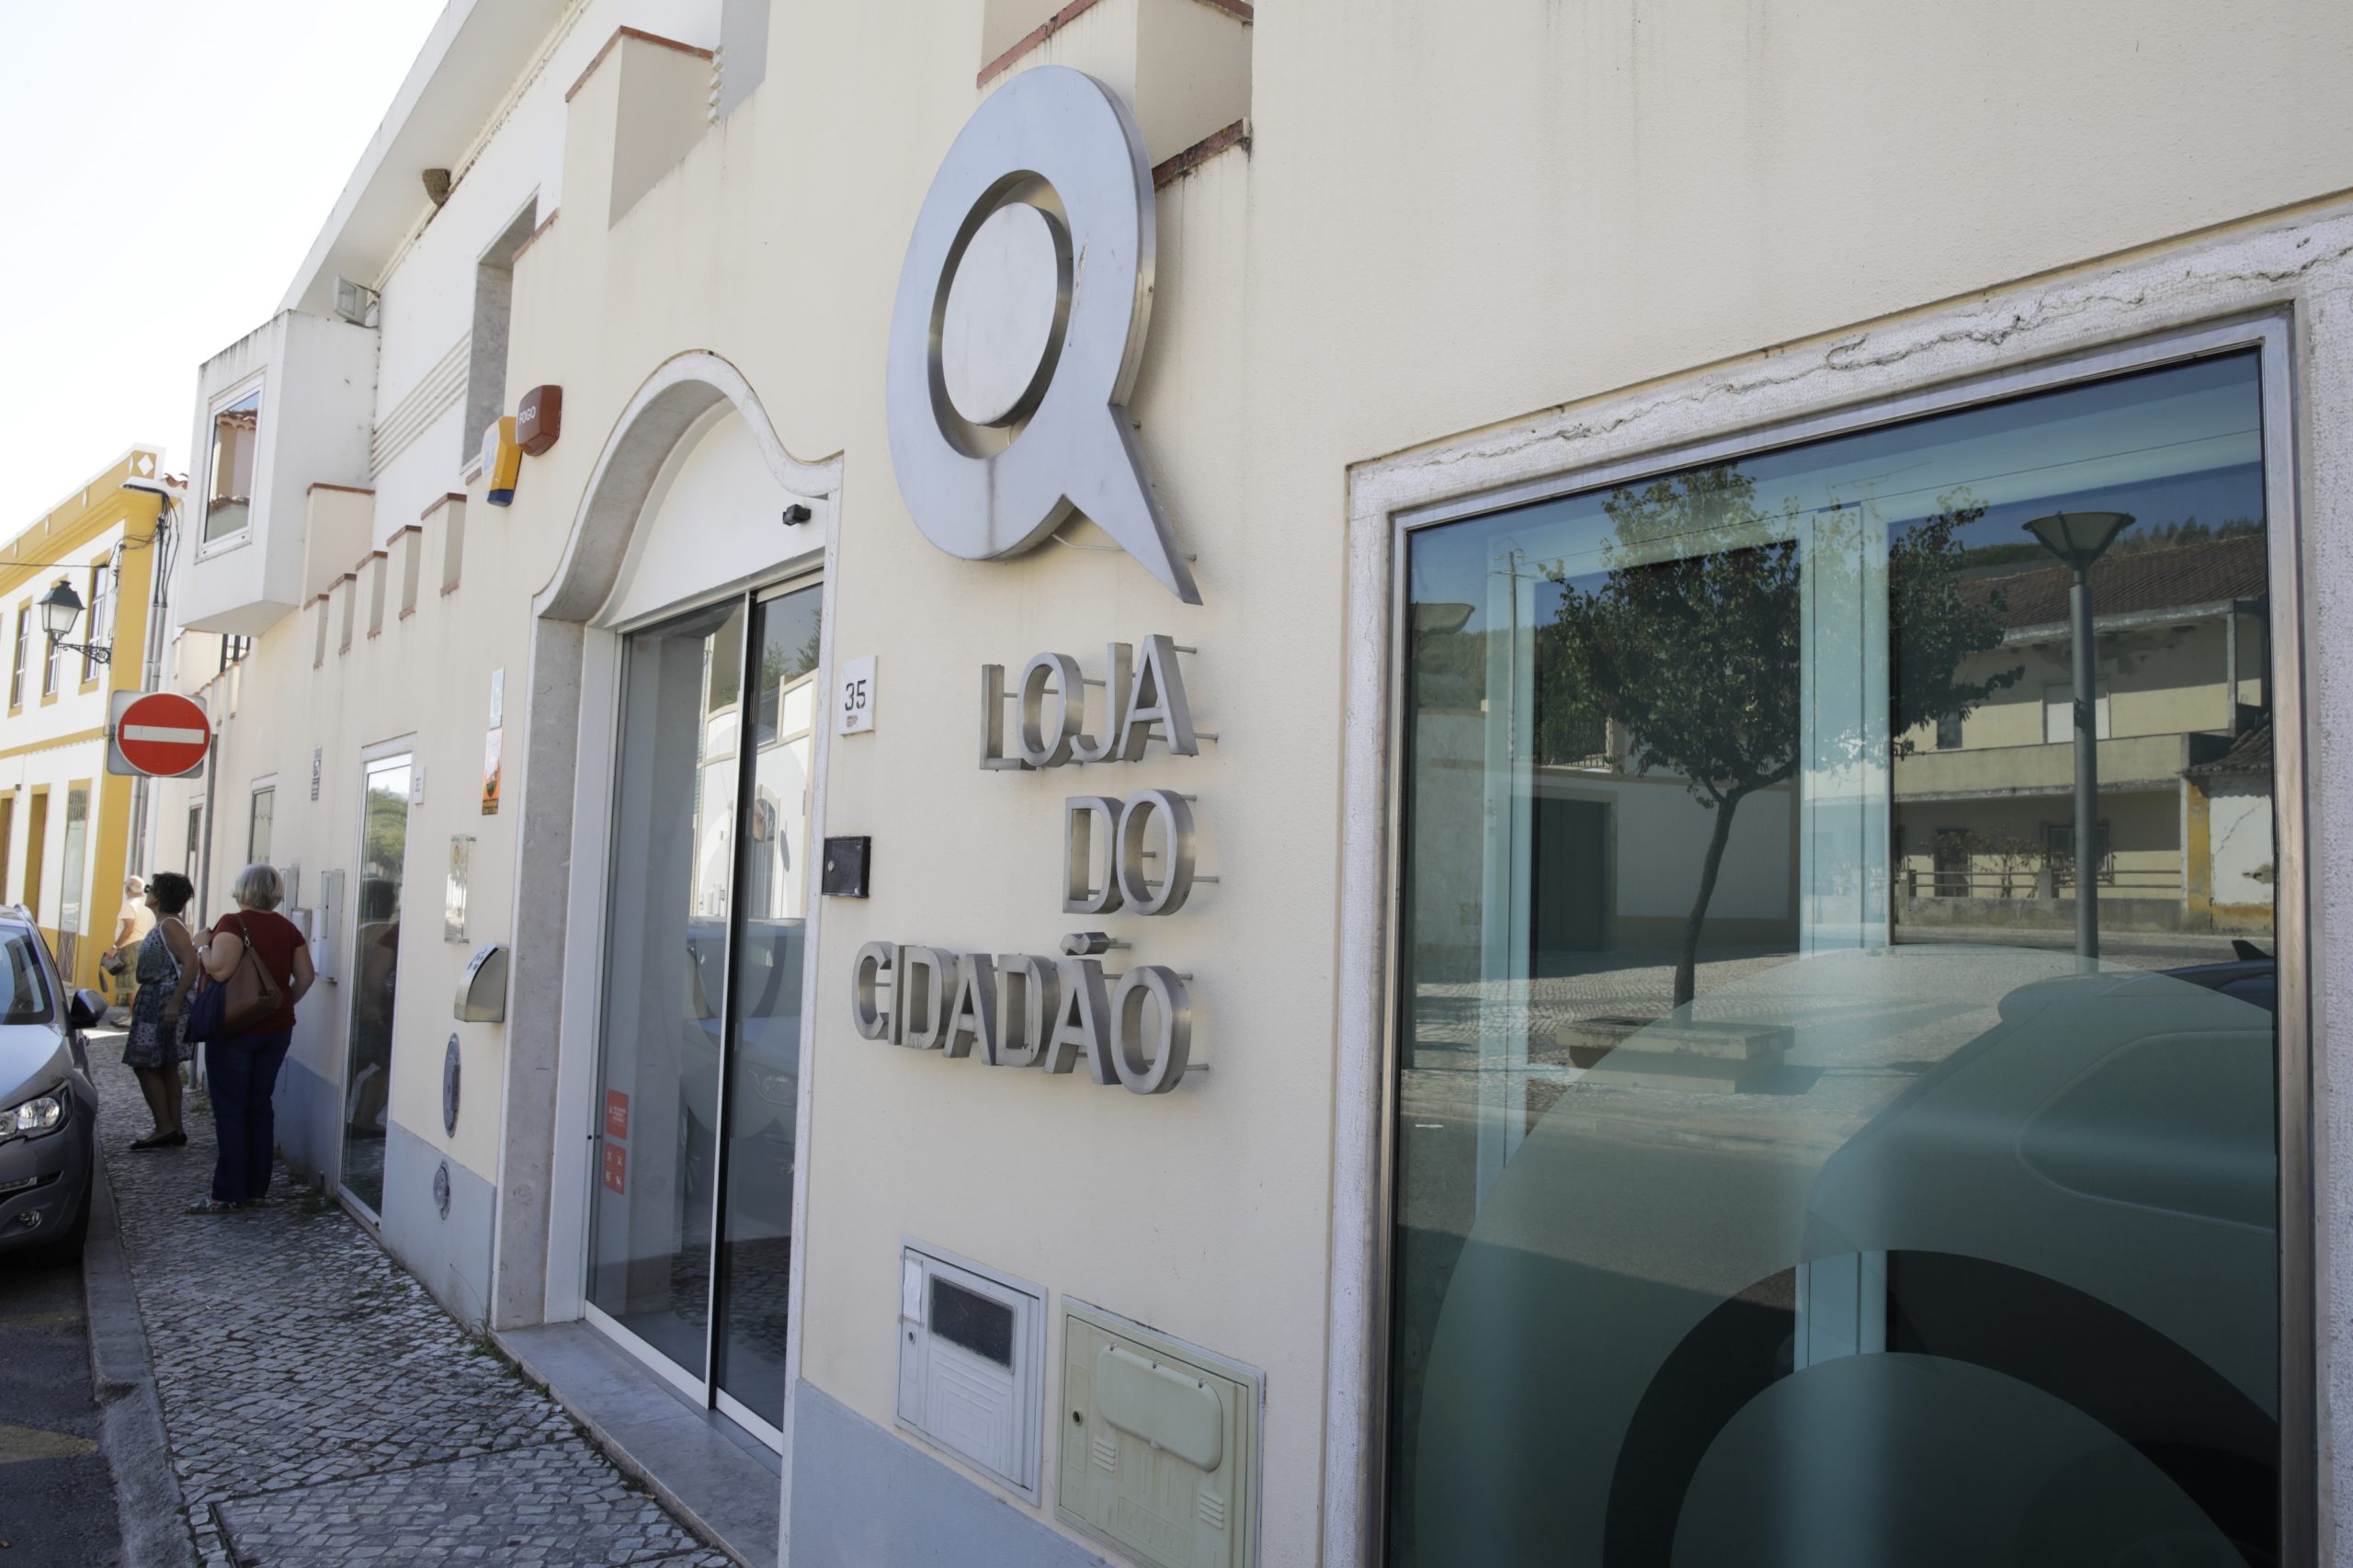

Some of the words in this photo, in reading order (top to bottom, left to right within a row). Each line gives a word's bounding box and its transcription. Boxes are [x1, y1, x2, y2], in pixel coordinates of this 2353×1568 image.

[519, 405, 536, 426] FOGO
[845, 679, 867, 711] 35
[980, 634, 1199, 770] LOJA
[1063, 789, 1195, 915] DO
[852, 932, 1191, 1095] CIDADÃO
